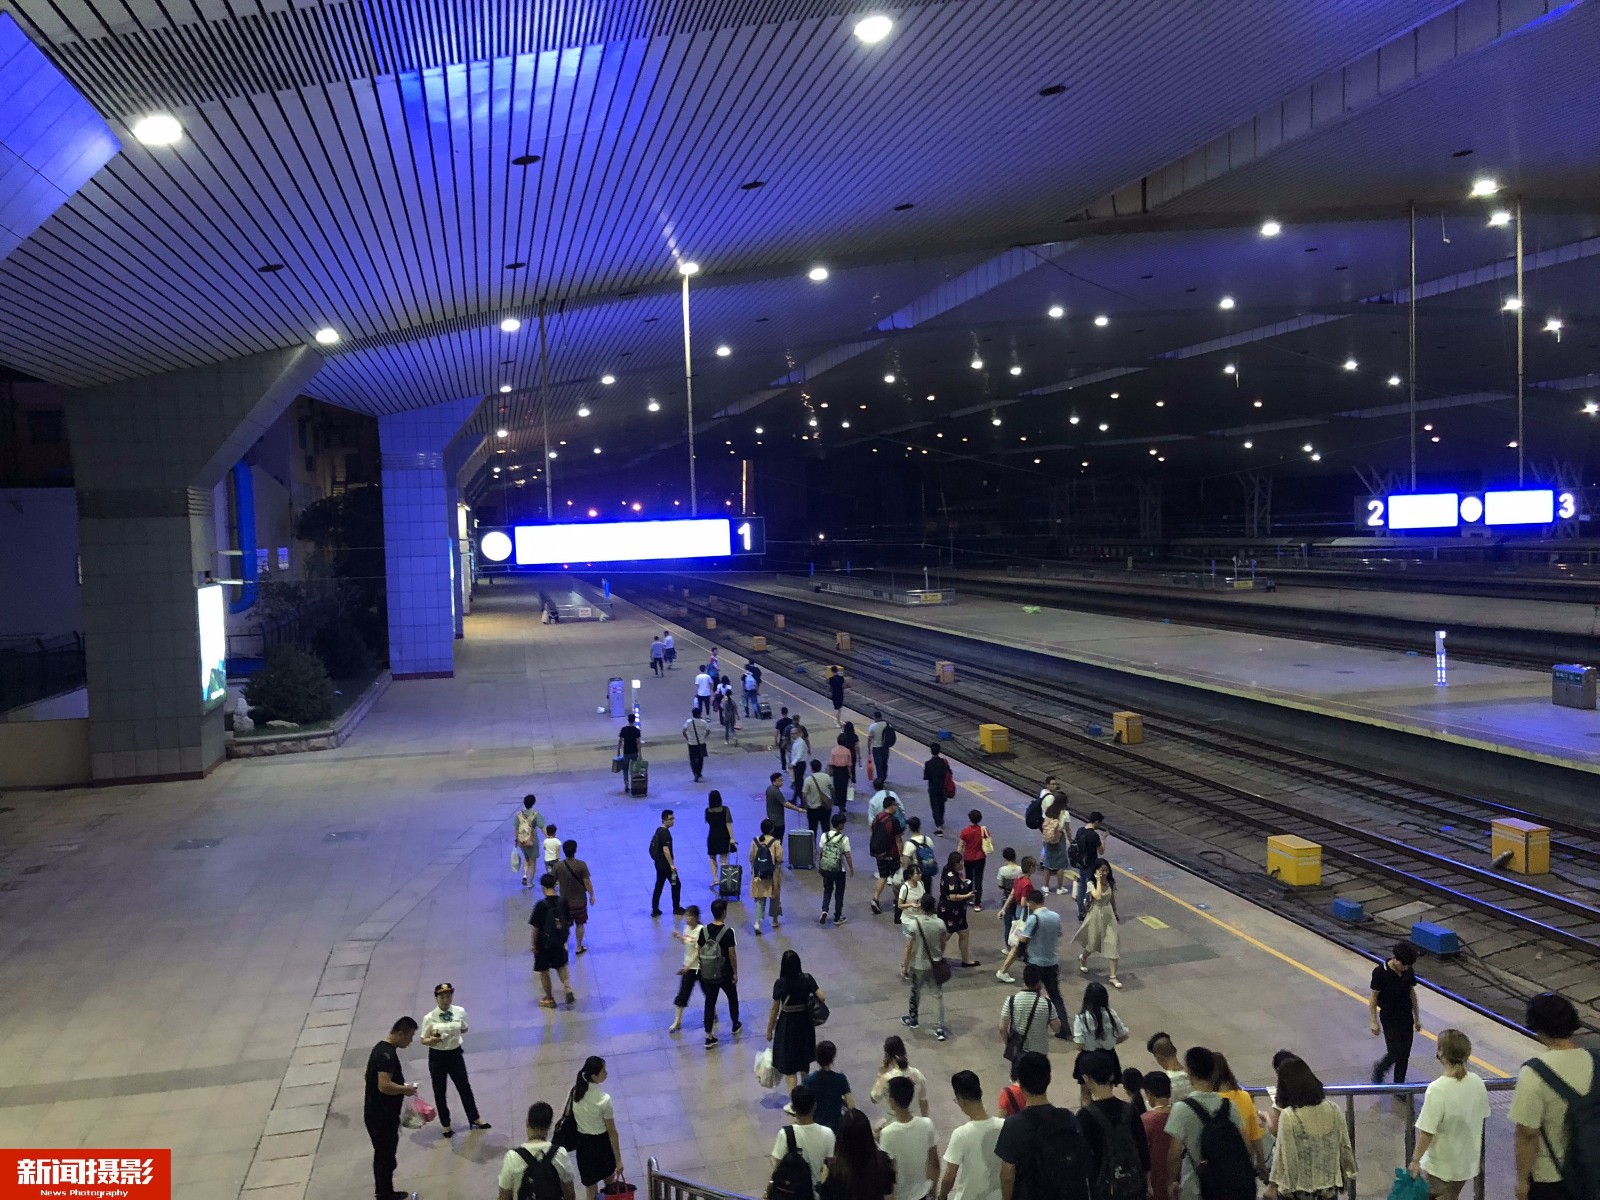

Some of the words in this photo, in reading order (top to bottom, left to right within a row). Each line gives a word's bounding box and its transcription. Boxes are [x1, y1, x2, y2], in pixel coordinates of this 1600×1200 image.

[1367, 500, 1385, 526] 2
[1558, 493, 1576, 519] 3
[737, 522, 751, 551] 1
